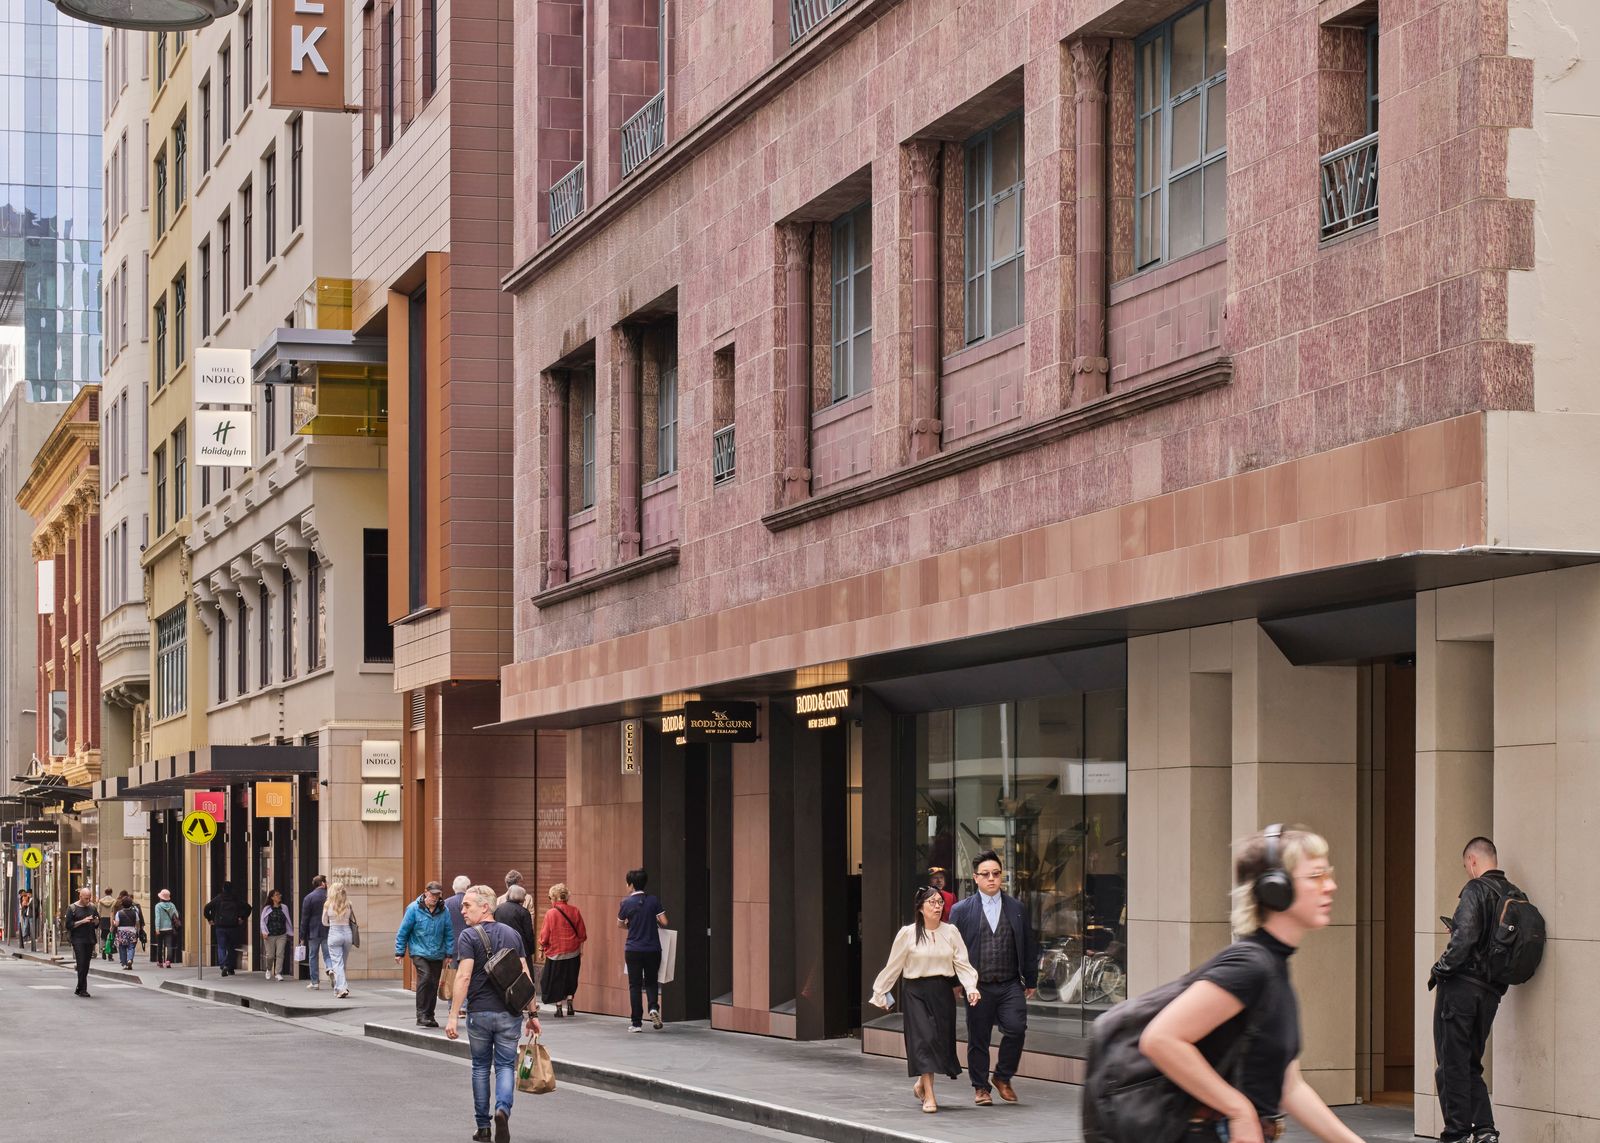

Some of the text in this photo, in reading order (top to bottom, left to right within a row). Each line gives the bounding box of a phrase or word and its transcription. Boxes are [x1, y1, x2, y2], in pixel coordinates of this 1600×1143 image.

[202, 374, 245, 385] INDIGO
[201, 446, 247, 457] Holiday Inn
[796, 688, 849, 714] RODD & GUNN
[661, 715, 679, 733] RODD
[690, 719, 717, 728] RODD
[717, 719, 725, 728] &
[725, 720, 752, 729] GUNN
[808, 716, 837, 729] NEW ZEALAND
[626, 723, 635, 770] CELLAR
[366, 758, 397, 766] INDIGO
[365, 808, 388, 816] Holiday
[332, 867, 362, 878] HOTEL
